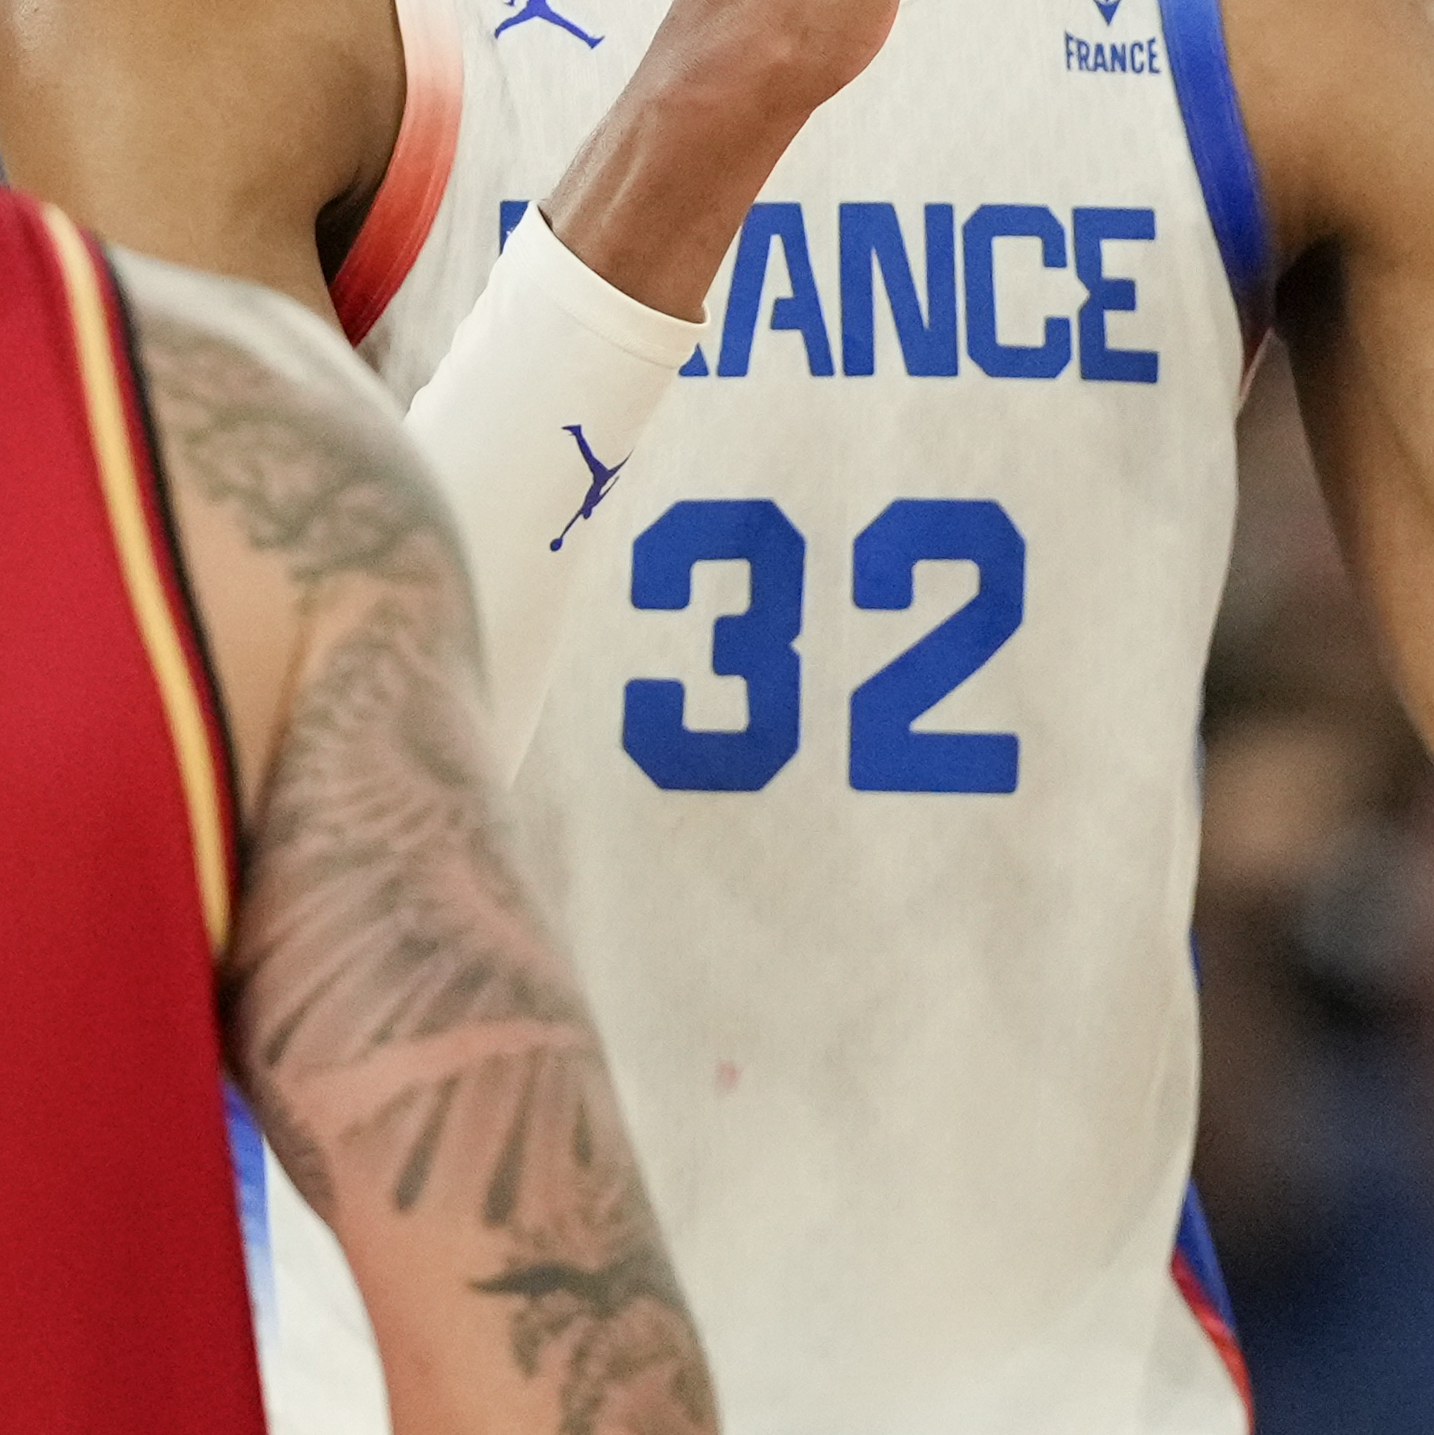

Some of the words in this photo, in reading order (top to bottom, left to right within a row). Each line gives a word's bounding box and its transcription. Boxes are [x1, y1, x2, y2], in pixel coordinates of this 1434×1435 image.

[1064, 30, 1162, 75] FRANCE
[499, 200, 1159, 384] ANCE
[622, 498, 1027, 794] 32
